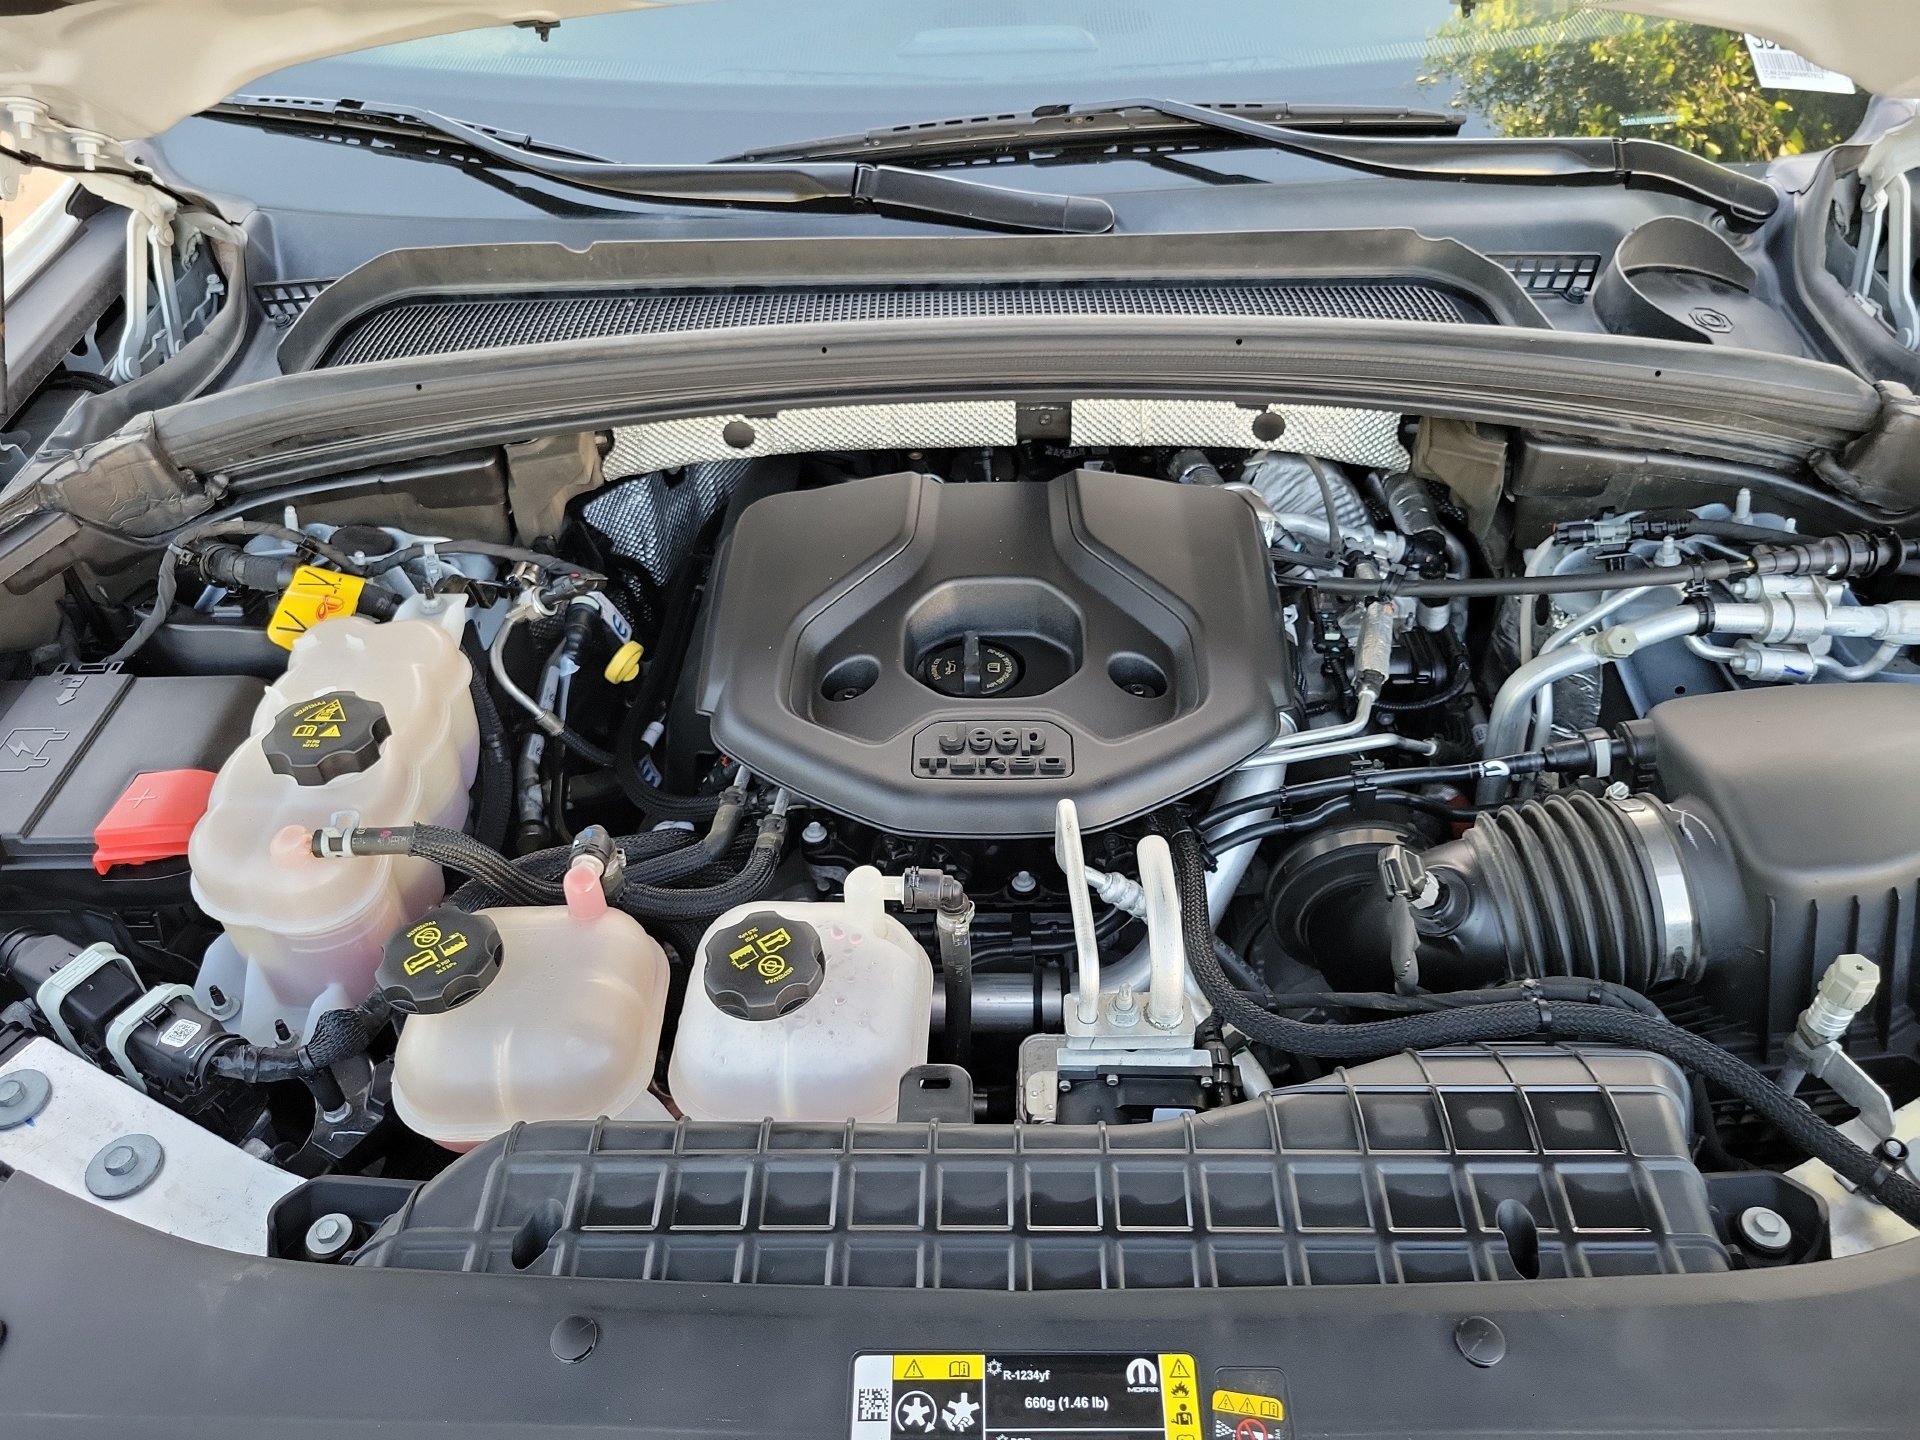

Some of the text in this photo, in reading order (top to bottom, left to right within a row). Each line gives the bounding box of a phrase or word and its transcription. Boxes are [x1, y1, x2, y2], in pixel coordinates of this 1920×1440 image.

[939, 722, 1047, 756] Jeep
[919, 756, 1067, 775] TURBO
[1003, 1370, 1051, 1382] R-1234yf
[1024, 1396, 1109, 1411] 660g (1.46 lb)
